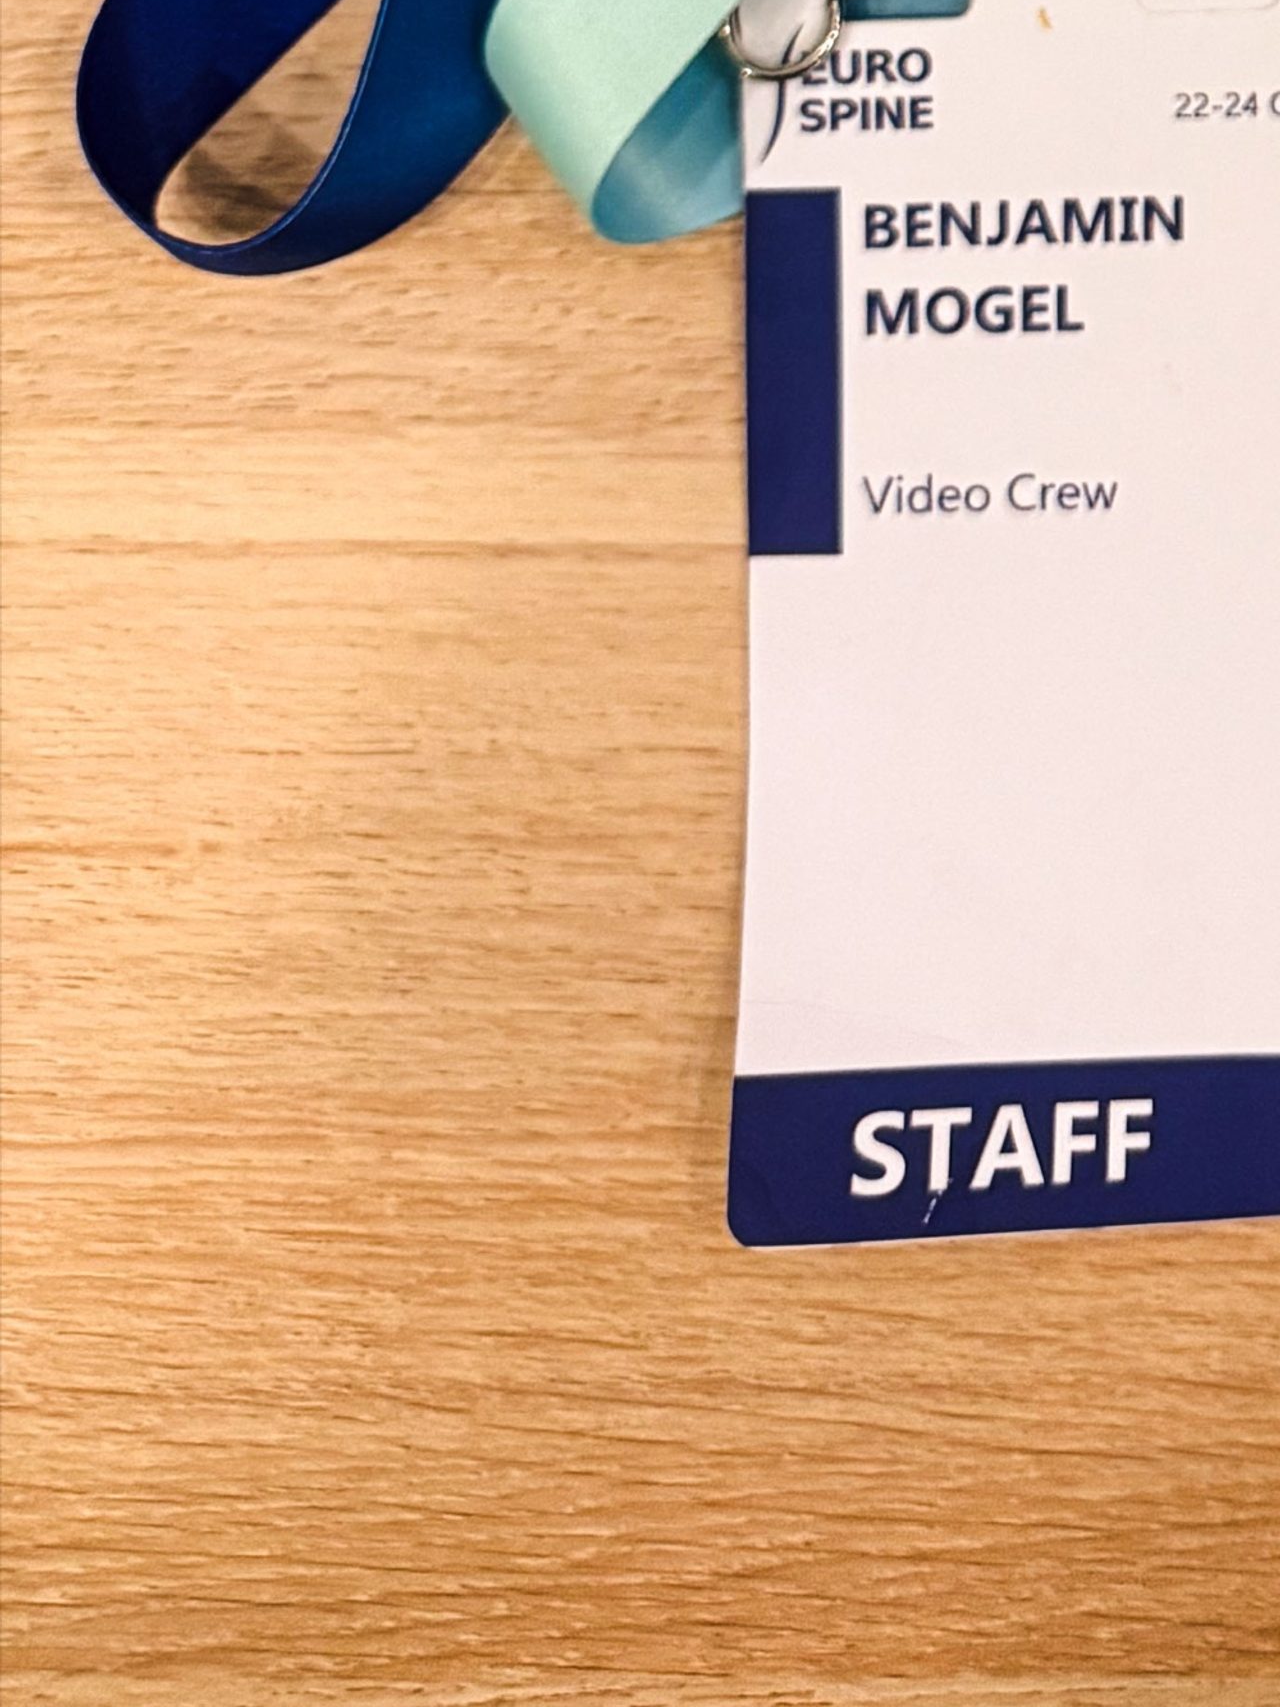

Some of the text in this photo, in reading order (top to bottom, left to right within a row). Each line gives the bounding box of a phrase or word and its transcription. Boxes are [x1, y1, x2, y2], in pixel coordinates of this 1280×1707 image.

[800, 95, 934, 134] SPINE
[1174, 90, 1259, 120] 22-24
[864, 195, 1185, 250] BENJAMIN
[865, 284, 1085, 337] MOGEL
[862, 472, 1119, 515] Video Crew
[850, 1097, 1155, 1200] STAFF
